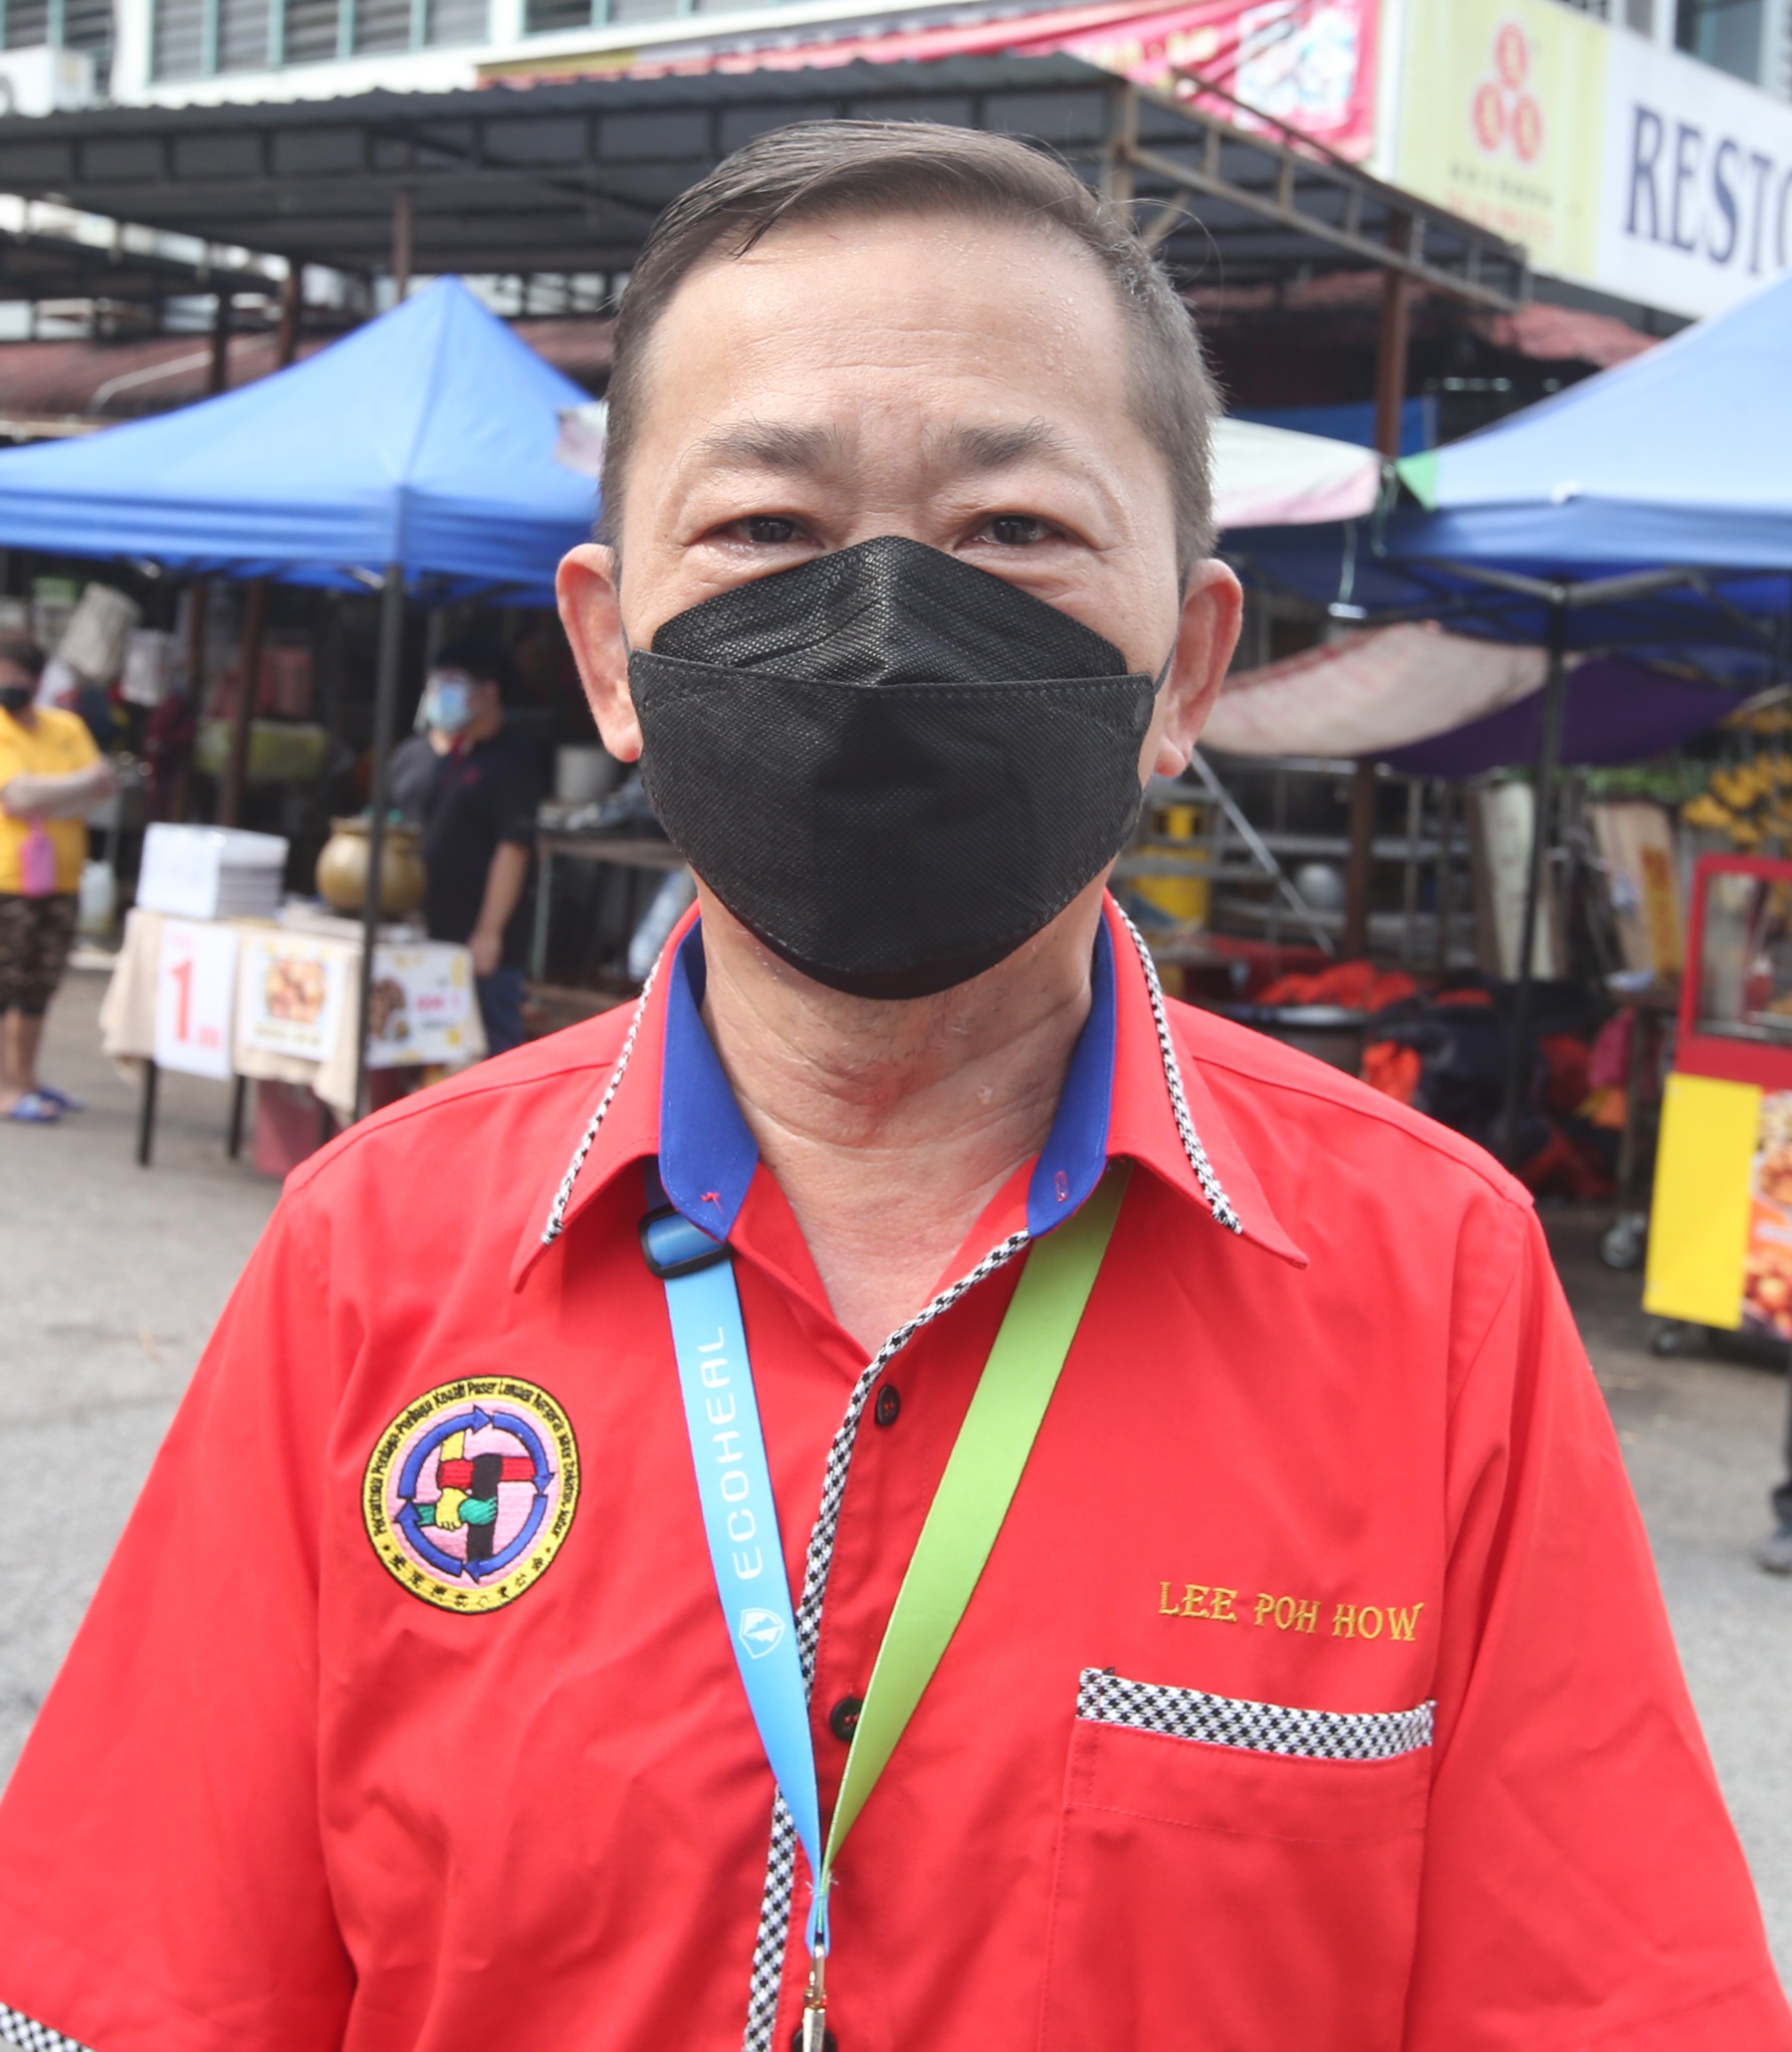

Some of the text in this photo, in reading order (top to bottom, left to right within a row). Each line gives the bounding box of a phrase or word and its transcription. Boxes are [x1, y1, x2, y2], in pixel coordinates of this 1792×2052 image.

[697, 1326, 764, 1579] ECOHEAL
[1159, 1582, 1424, 1641] LEE POH HOW
